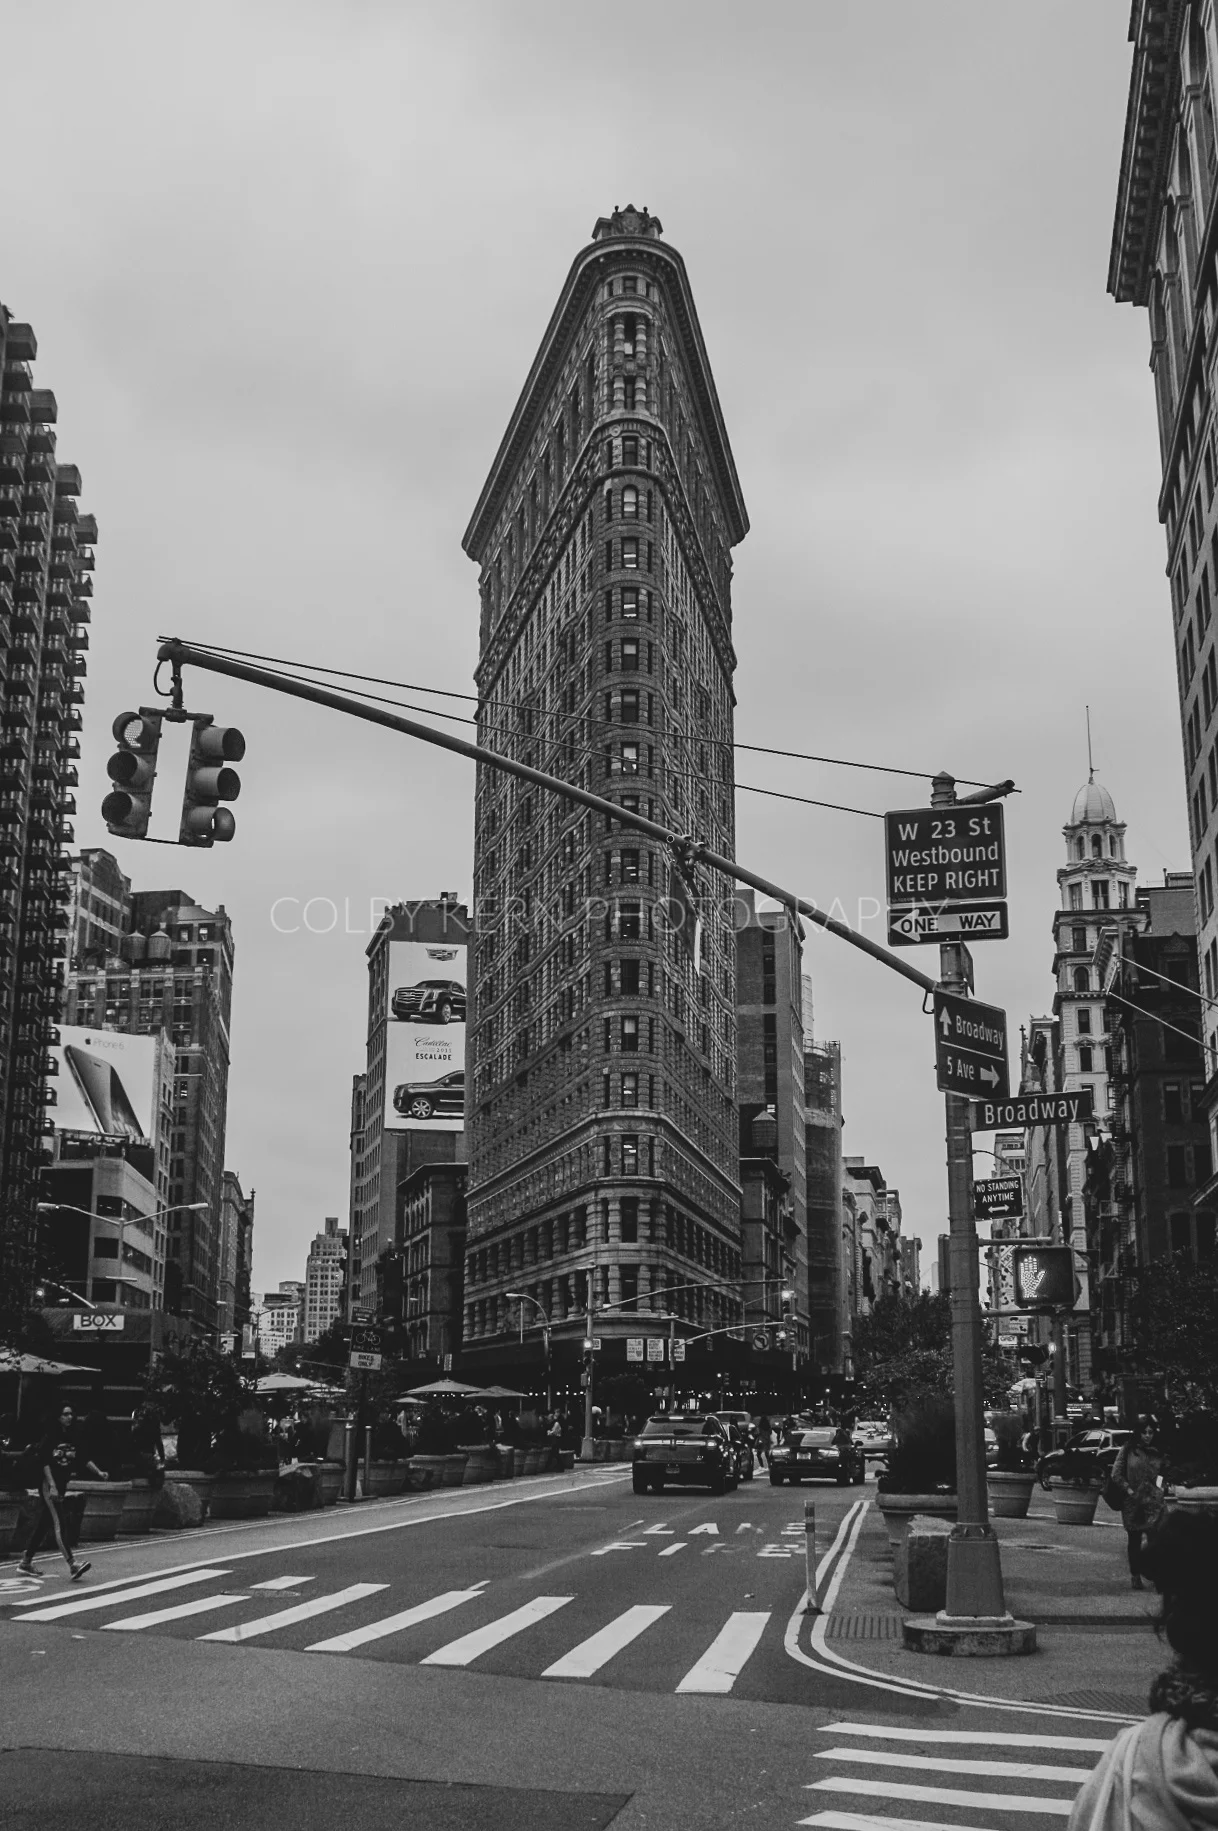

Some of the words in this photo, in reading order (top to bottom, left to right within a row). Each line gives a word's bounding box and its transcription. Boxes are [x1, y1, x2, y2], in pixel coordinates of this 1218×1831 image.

[898, 823, 919, 841] W
[931, 820, 956, 839] 23
[969, 817, 991, 836] St
[892, 841, 999, 867] Westbound
[894, 873, 938, 893] KEEP
[945, 868, 1000, 889] RIGHT
[900, 917, 939, 934] ONE
[959, 913, 996, 930] WAY
[414, 1036, 452, 1047] Cadillac
[956, 1015, 1004, 1051] Broadway
[947, 1056, 953, 1075] 5
[957, 1059, 975, 1080] Ave
[985, 1098, 1079, 1124] Broadway
[976, 1184, 986, 1193] NO
[987, 1180, 1019, 1191] STANDING
[982, 1191, 1015, 1203] ANYTIME
[81, 1315, 116, 1327] BOX
